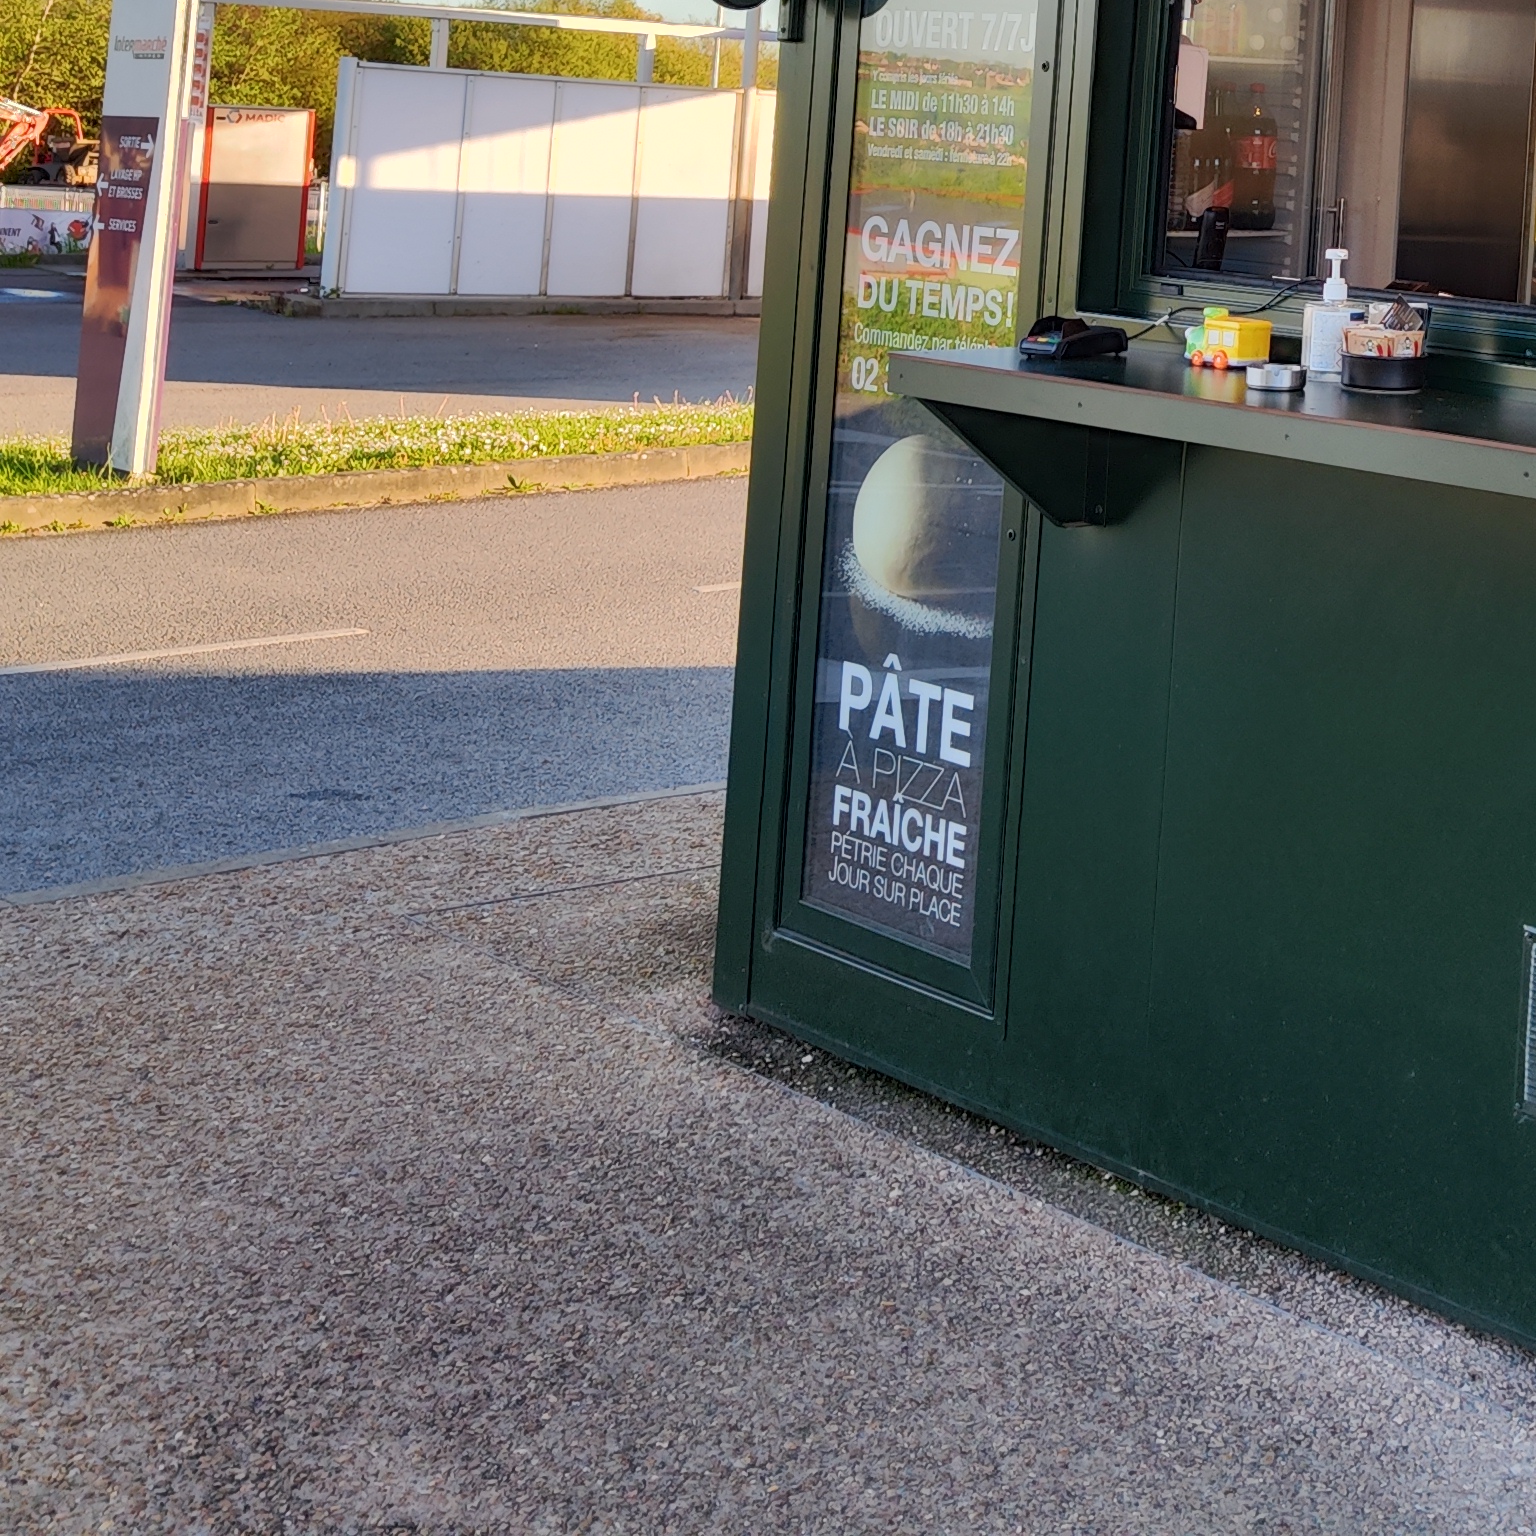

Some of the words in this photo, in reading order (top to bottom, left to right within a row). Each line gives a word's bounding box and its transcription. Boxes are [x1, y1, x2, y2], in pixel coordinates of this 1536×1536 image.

[114, 35, 167, 52] Intermarché
[875, 9, 974, 50] OUVERT
[871, 89, 887, 109] LE
[890, 90, 919, 111] MIDI
[922, 92, 938, 112] de
[941, 93, 978, 114] 11h30
[981, 94, 989, 115] à
[993, 95, 1015, 117] 14h
[245, 113, 285, 123] MADIC
[869, 116, 885, 136] LE
[888, 118, 918, 138] SOIR
[922, 120, 936, 140] de
[941, 122, 961, 142] 18h
[976, 123, 1014, 145] 21h30
[119, 136, 141, 149] SORTIE
[868, 143, 903, 159] Vendredi
[904, 148, 912, 160] et
[914, 146, 944, 161] samedi
[110, 169, 132, 179] LAVAGE
[117, 188, 143, 200] BROSSES
[108, 218, 137, 232] SERVICES
[861, 215, 1019, 276] GAGNEZ
[858, 273, 898, 312] DU
[854, 322, 929, 351] Commandez
[852, 357, 879, 392] 02
[839, 653, 974, 768] PÂTE
[836, 727, 860, 783] À
[873, 748, 966, 818] PIZZA
[833, 784, 967, 869] FRAÎCHE
[830, 829, 887, 872] PÉTRIE
[891, 852, 964, 899] CHAQUE
[828, 855, 870, 894] JOUR
[873, 876, 906, 906] SUR
[909, 887, 961, 927] PLACE
